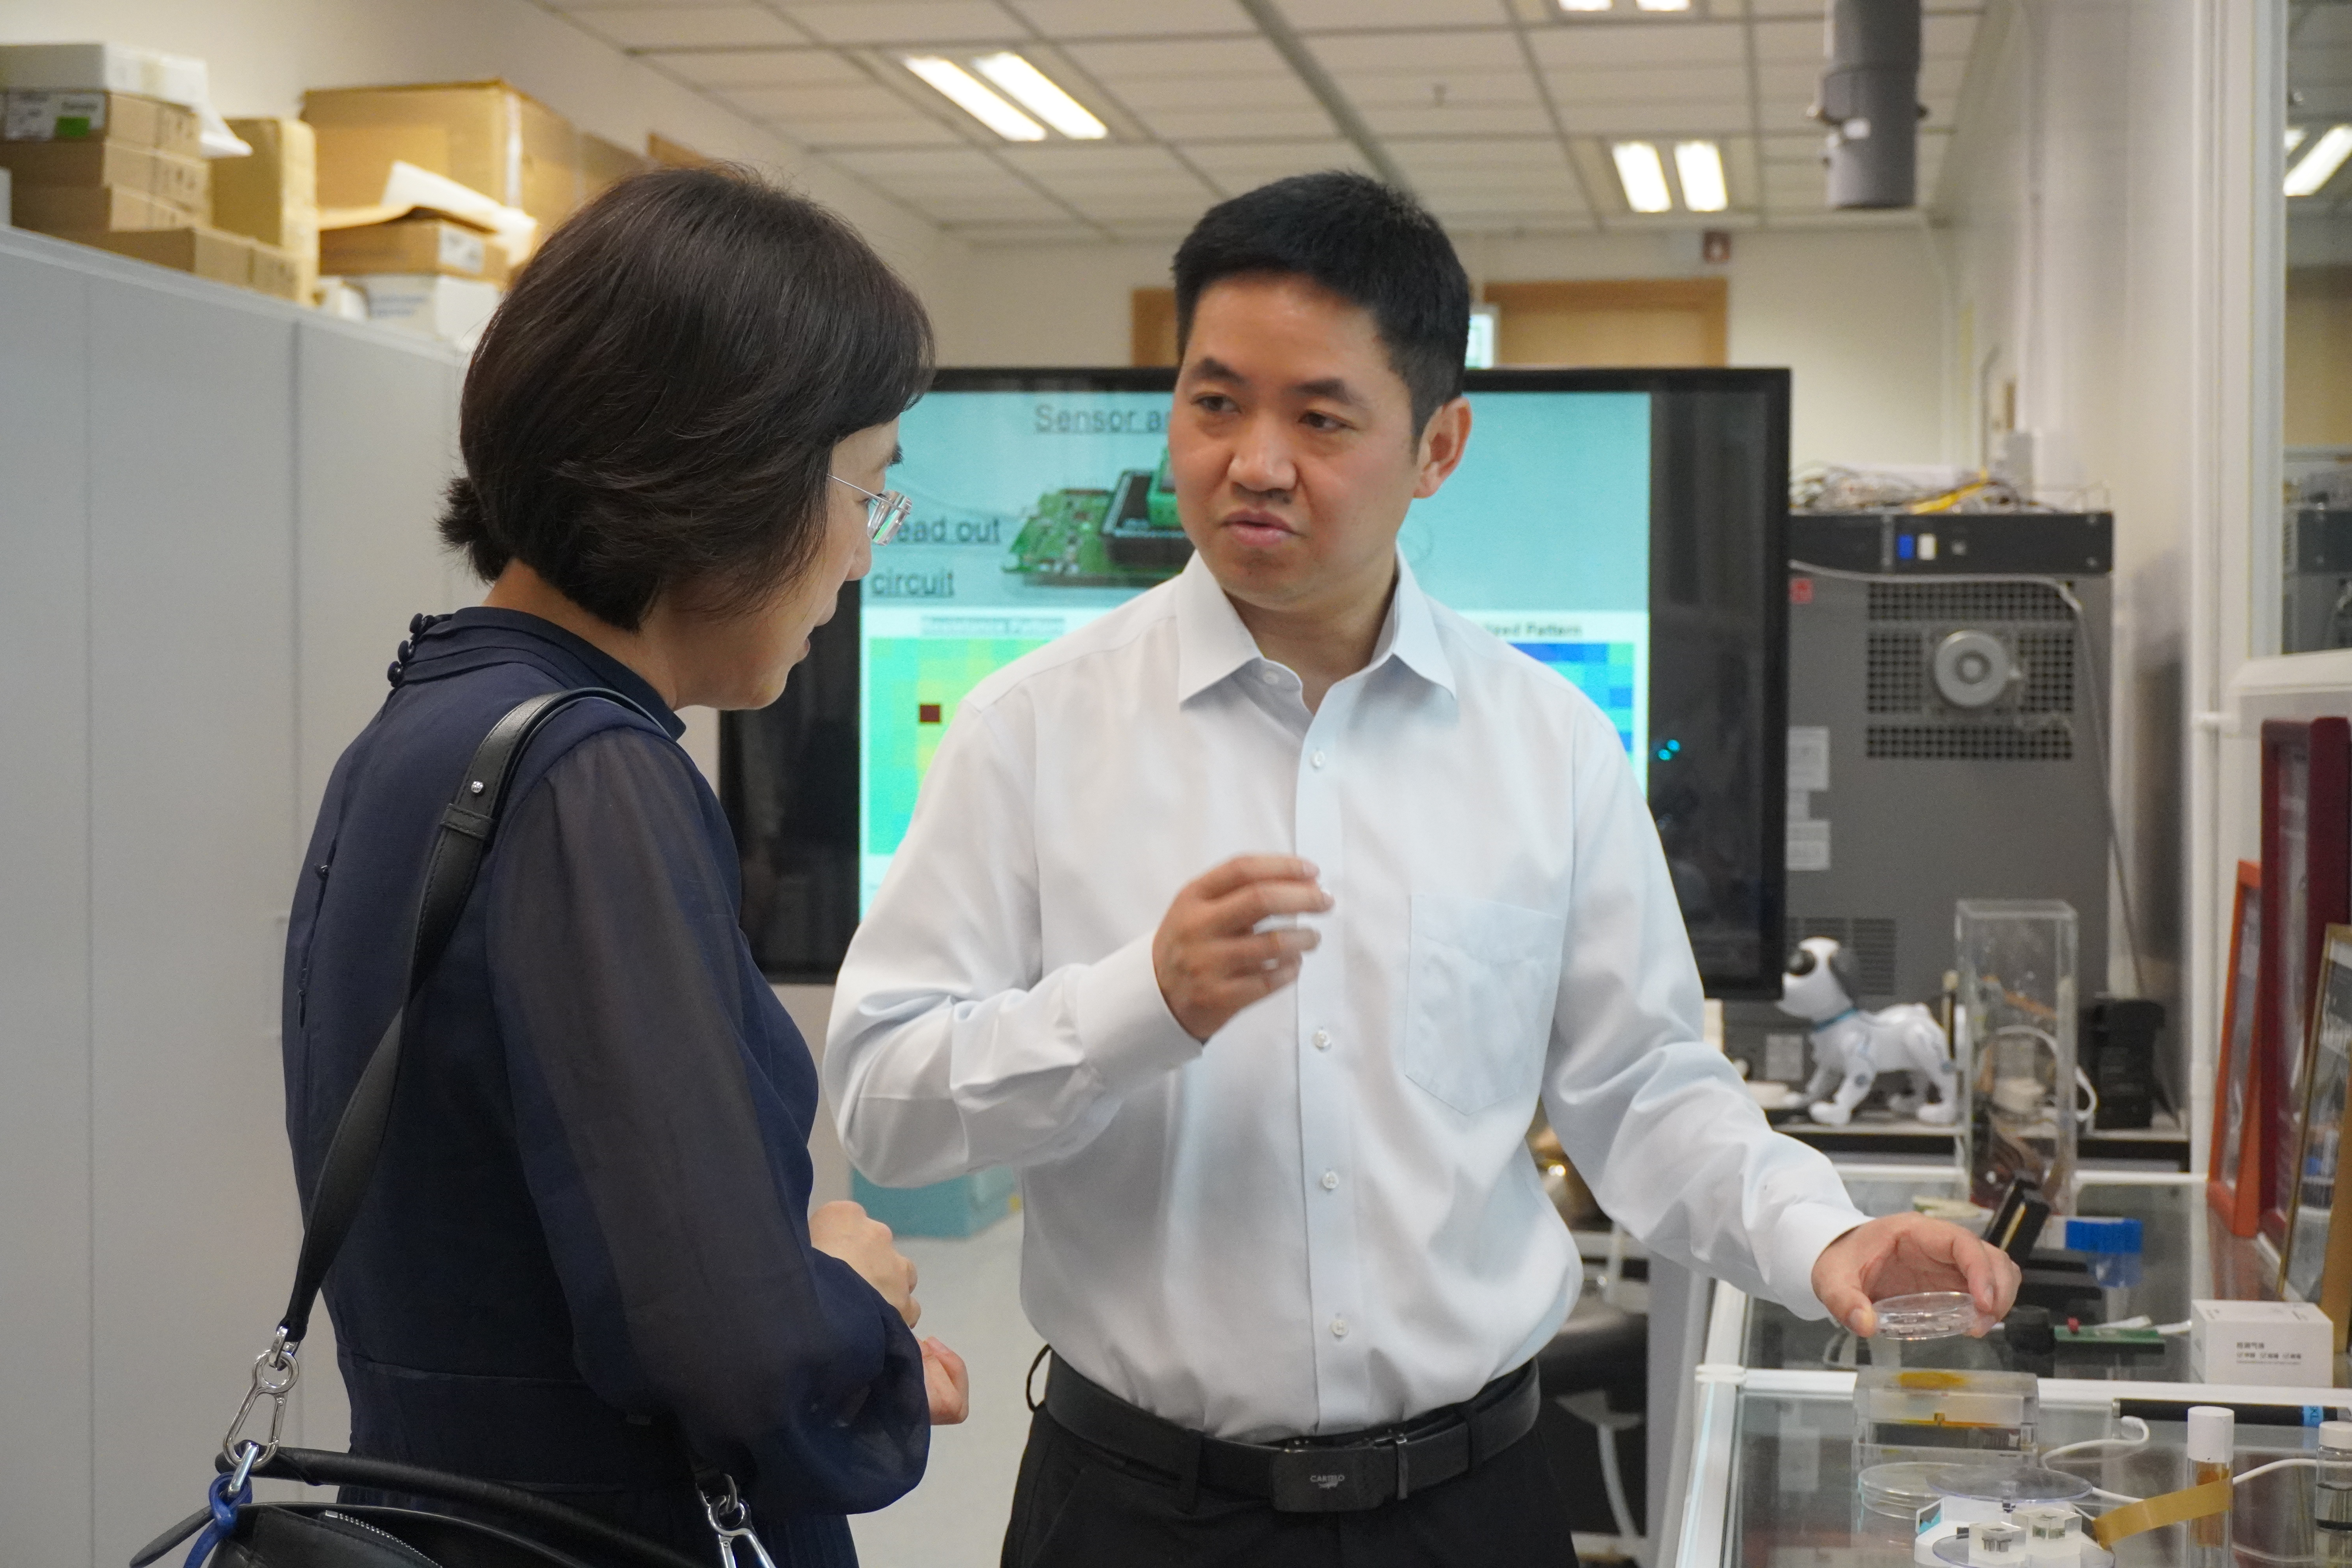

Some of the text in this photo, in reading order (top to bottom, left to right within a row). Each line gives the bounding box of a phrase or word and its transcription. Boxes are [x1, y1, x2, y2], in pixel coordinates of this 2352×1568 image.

[1035, 404, 1136, 432] Sensor
[889, 517, 1001, 543] ead out
[870, 567, 954, 596] circuit
